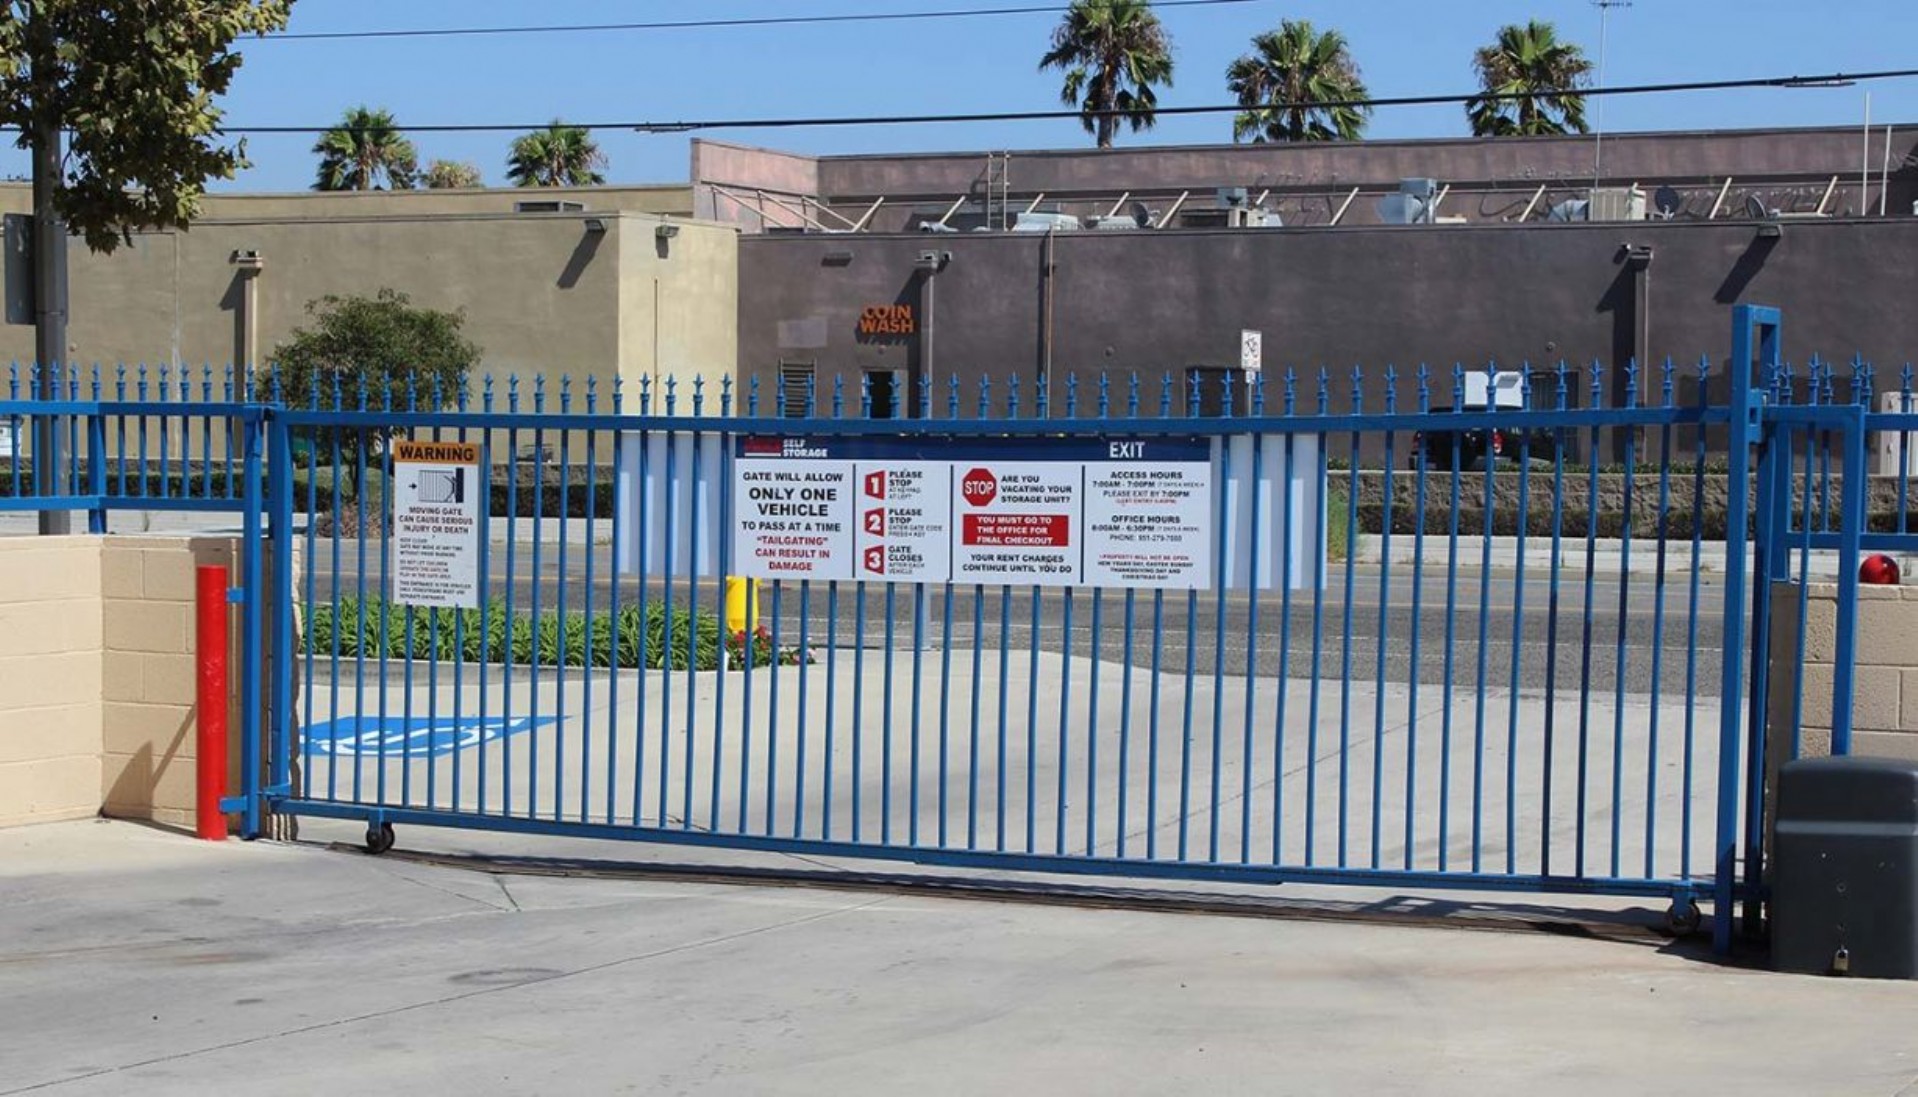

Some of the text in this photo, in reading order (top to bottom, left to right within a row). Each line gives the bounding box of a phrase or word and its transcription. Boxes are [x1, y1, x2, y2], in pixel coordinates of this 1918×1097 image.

[864, 304, 911, 319] COIN
[861, 319, 914, 333] WASH
[783, 439, 806, 447] SELF
[400, 446, 474, 461] WARNING
[783, 448, 828, 457] STORAGE
[1109, 441, 1145, 458] EXIT
[743, 471, 843, 481] GATE WILL ALLOW
[1001, 475, 1019, 483] ARE
[1110, 471, 1147, 479] ACCESS
[871, 477, 879, 494] 1
[964, 480, 994, 495] STOP
[1093, 480, 1120, 488] 7:00AM
[1127, 480, 1155, 488] 7:00PM
[1001, 485, 1045, 493] VACATING
[749, 487, 837, 501] ONLY ONE
[409, 507, 463, 516] MOVING GATE
[758, 503, 828, 517] VEHICLE
[889, 508, 922, 516] PLEASE
[399, 515, 474, 525] CAN CAUSE SERIOUS
[869, 514, 881, 531] 2
[889, 516, 912, 524] STOP
[977, 516, 1052, 524] YOU MUST GO TO
[1111, 515, 1181, 523] OFFICE HOURS
[445, 526, 469, 534] DEATH
[742, 521, 841, 532] TO PASS AT A TIME
[977, 526, 994, 534] THE
[996, 526, 1028, 534] OFFICE
[977, 536, 1002, 544] FINAL
[755, 548, 830, 558] CAN RESULT IN
[869, 551, 881, 568] 3
[769, 562, 812, 570] DAMAGE
[1010, 564, 1036, 572] UNTIL
[1039, 564, 1057, 572] YOU
[1060, 565, 1072, 573] DO
